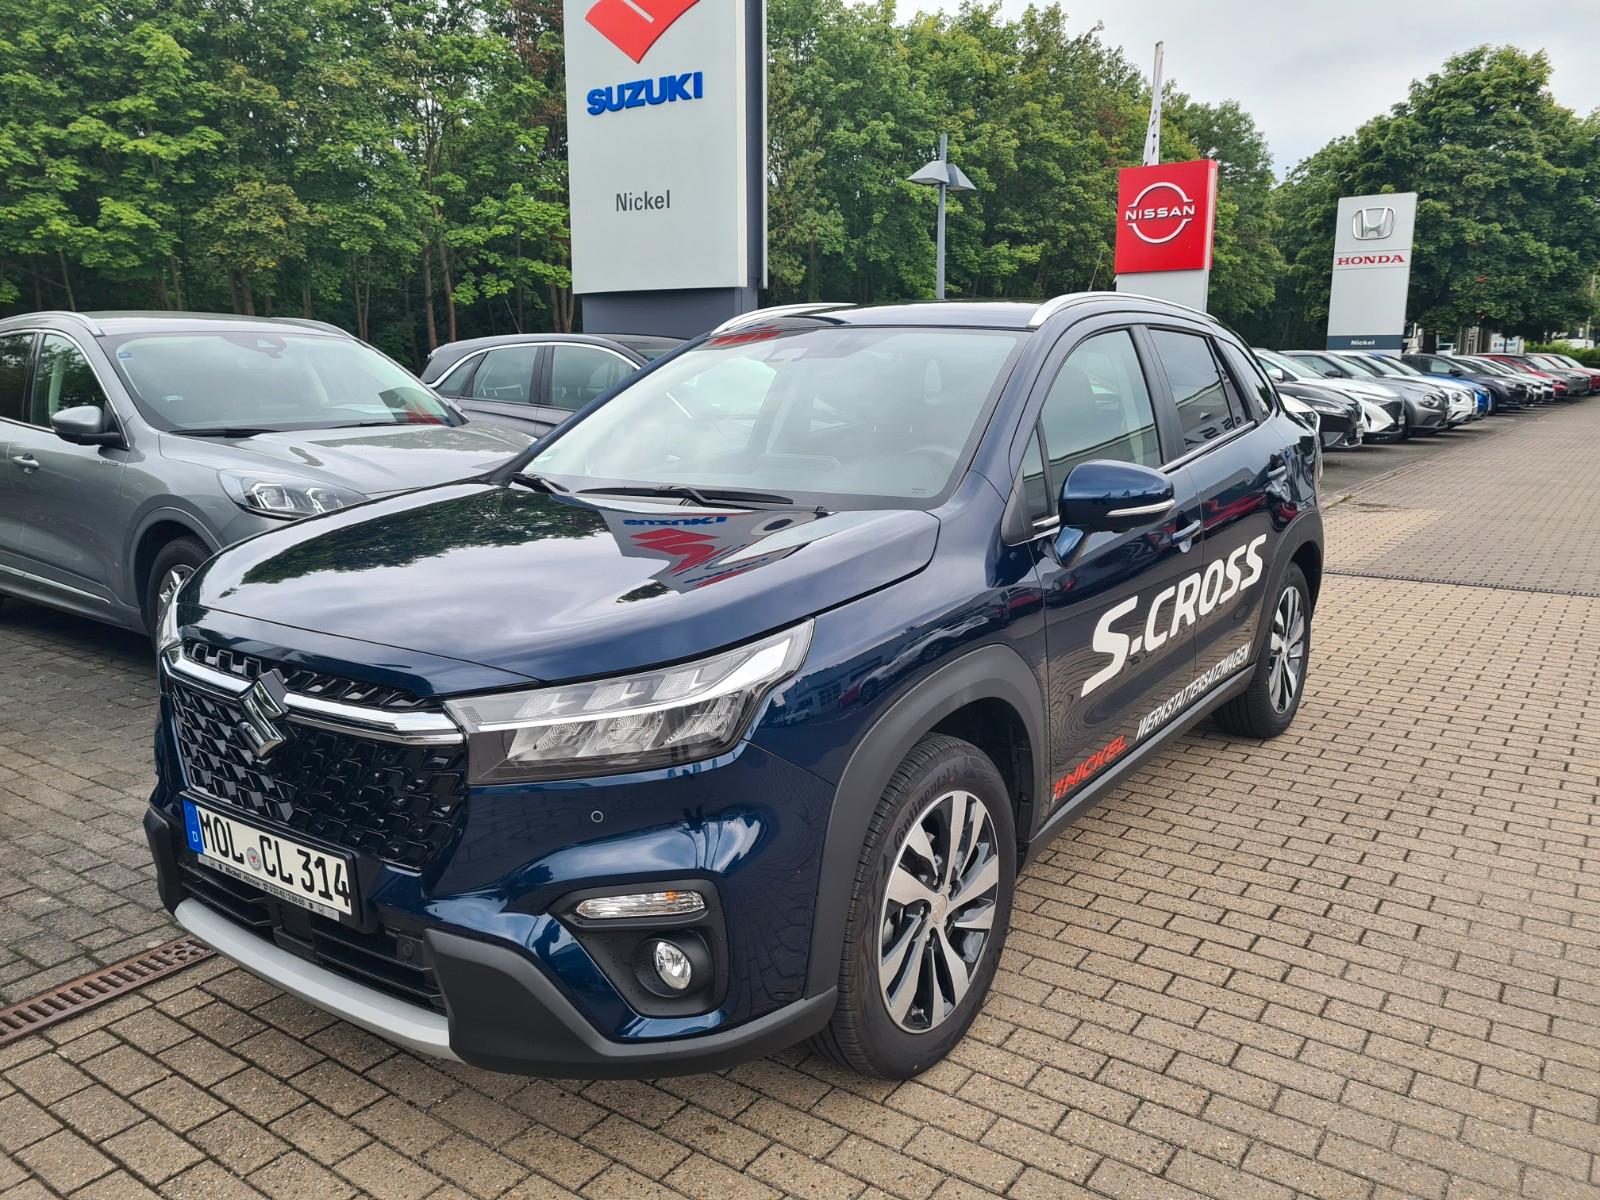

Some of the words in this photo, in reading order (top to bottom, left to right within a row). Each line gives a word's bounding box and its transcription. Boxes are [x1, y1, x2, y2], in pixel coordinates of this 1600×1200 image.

[587, 71, 703, 116] SUZUKI
[615, 189, 671, 212] Nickel
[1125, 204, 1196, 221] NISSAN
[1336, 254, 1406, 266] HONDA
[1135, 640, 1252, 741] WERKSTATTERSATZWAGEN
[197, 810, 245, 865] MOL
[258, 834, 294, 886] CL
[296, 848, 351, 908] 314
